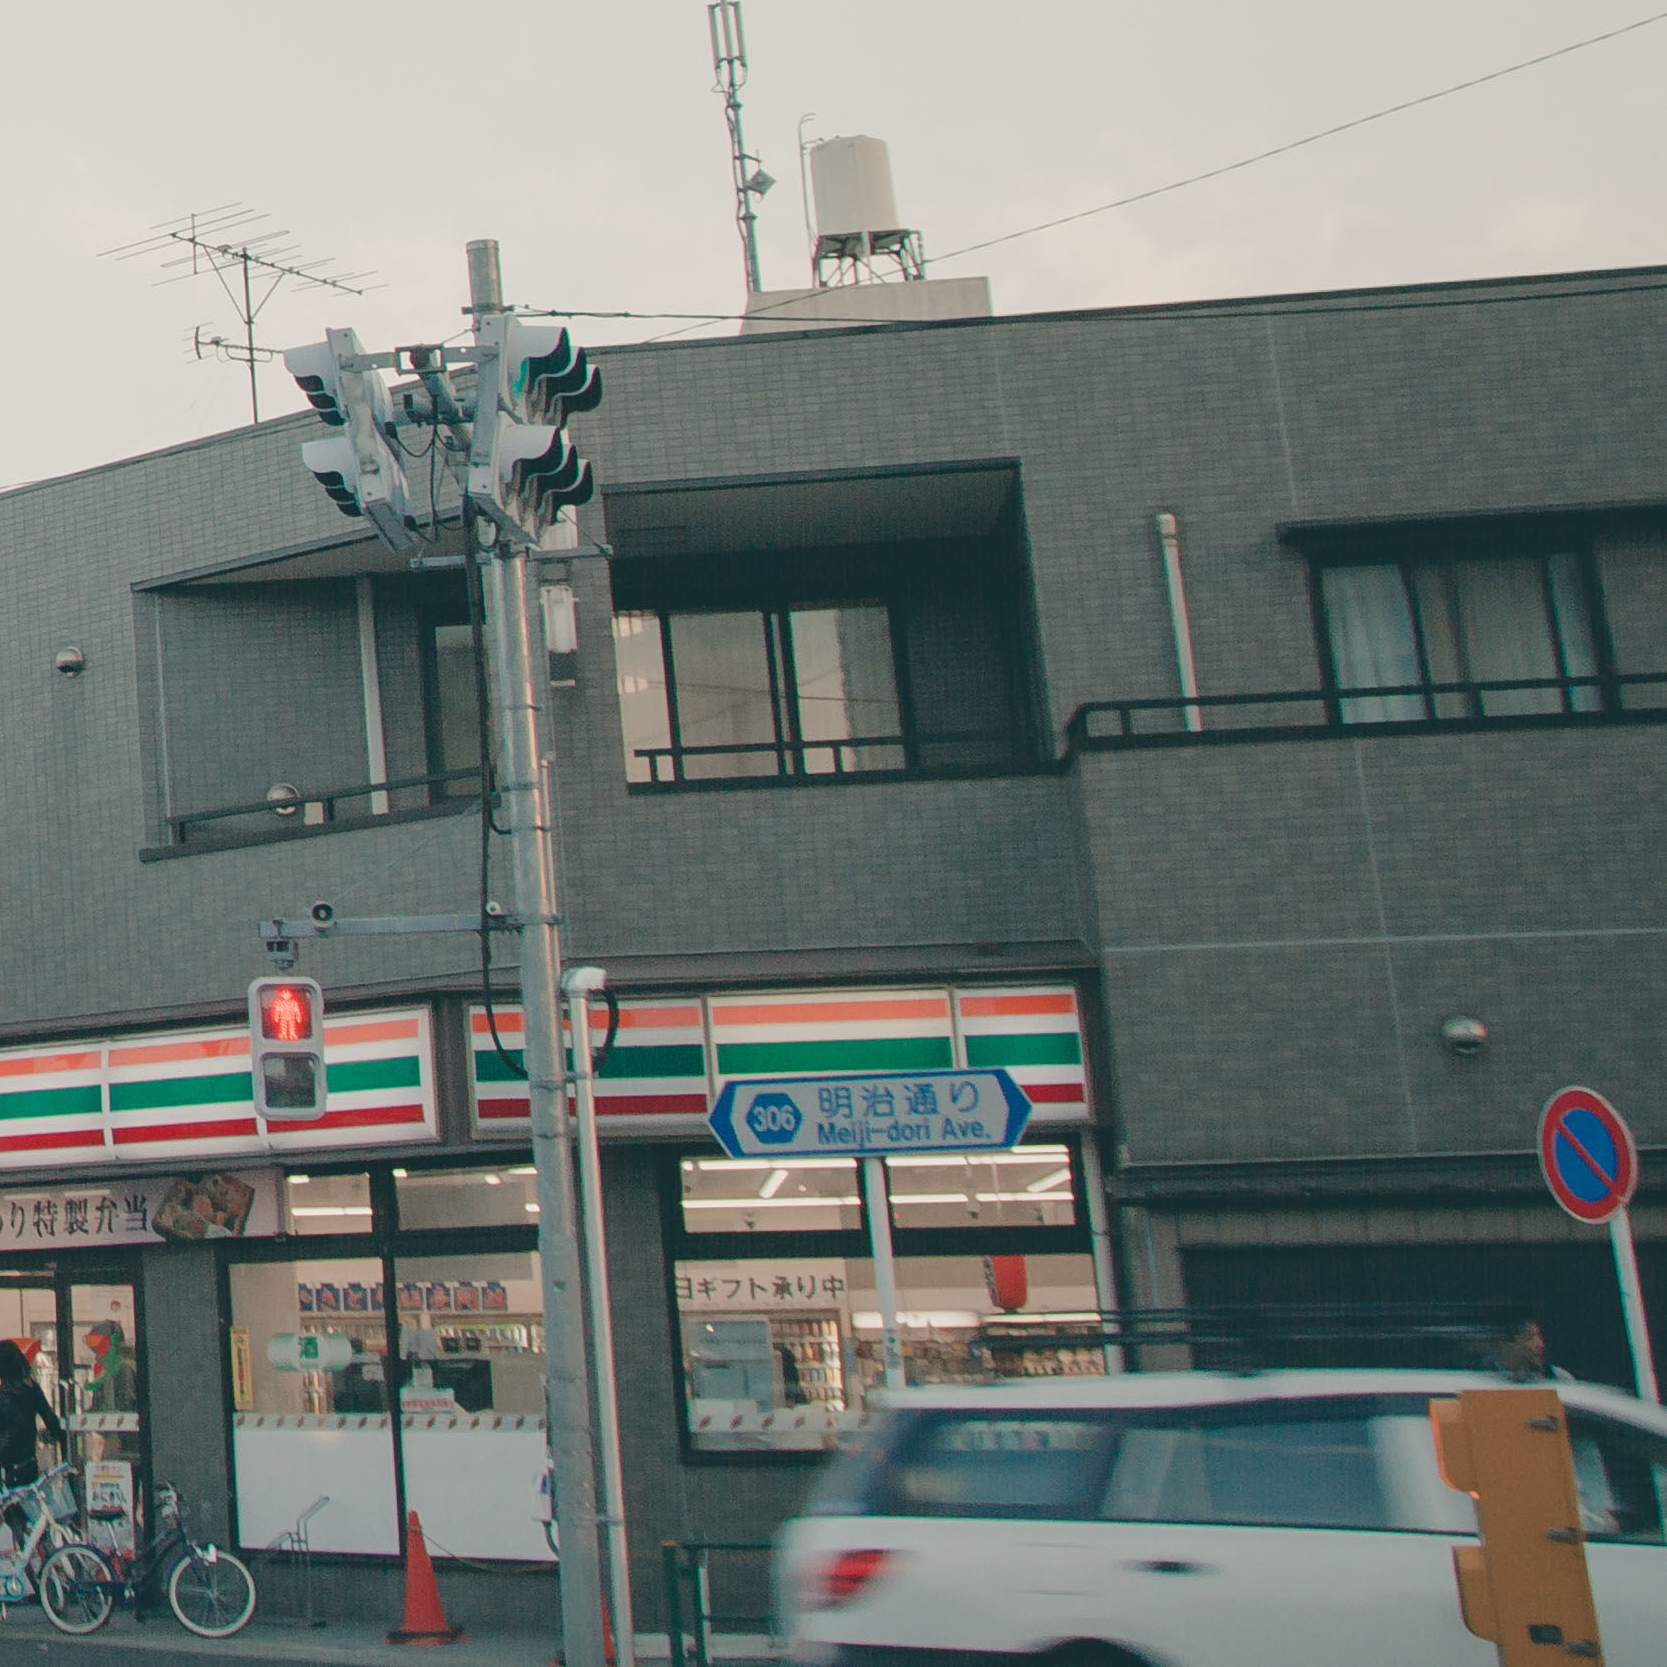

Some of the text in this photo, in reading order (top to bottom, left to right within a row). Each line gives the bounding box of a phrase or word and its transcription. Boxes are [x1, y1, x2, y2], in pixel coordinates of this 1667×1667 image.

[817, 1080, 980, 1119] 明治通り
[753, 1104, 797, 1132] 306
[816, 1117, 992, 1148] Meiji-dori Ave.
